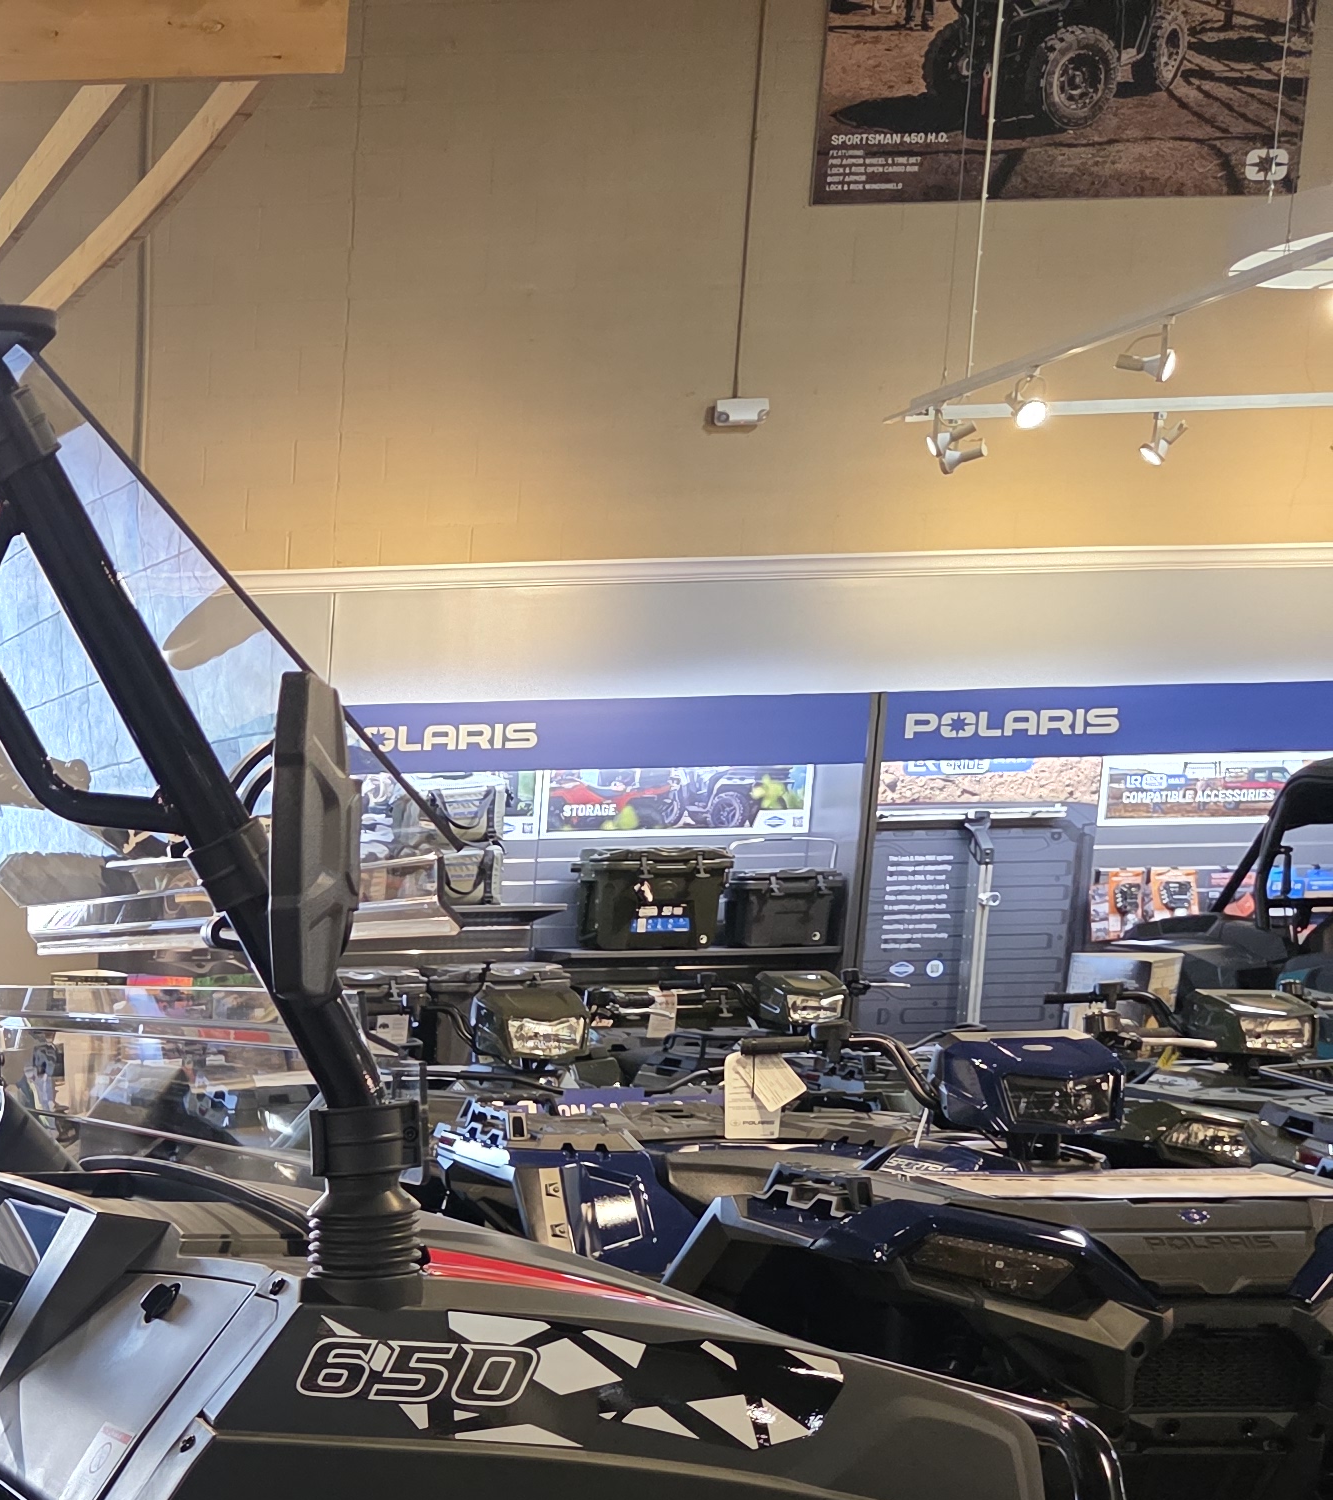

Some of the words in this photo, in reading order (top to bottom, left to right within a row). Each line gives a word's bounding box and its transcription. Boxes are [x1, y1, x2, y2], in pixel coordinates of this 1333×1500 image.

[830, 133, 901, 145] SPORTSMAN
[903, 132, 926, 144] 450
[927, 131, 949, 143] H.O.
[904, 708, 1120, 739] POLARIS
[362, 722, 539, 752] OLARIS
[1122, 790, 1195, 803] COMPATIBLE
[1195, 788, 1275, 803] ACCESSORIES
[562, 803, 617, 817] STORAGE
[1142, 1234, 1277, 1252] POLARIS
[296, 1338, 539, 1406] 650
